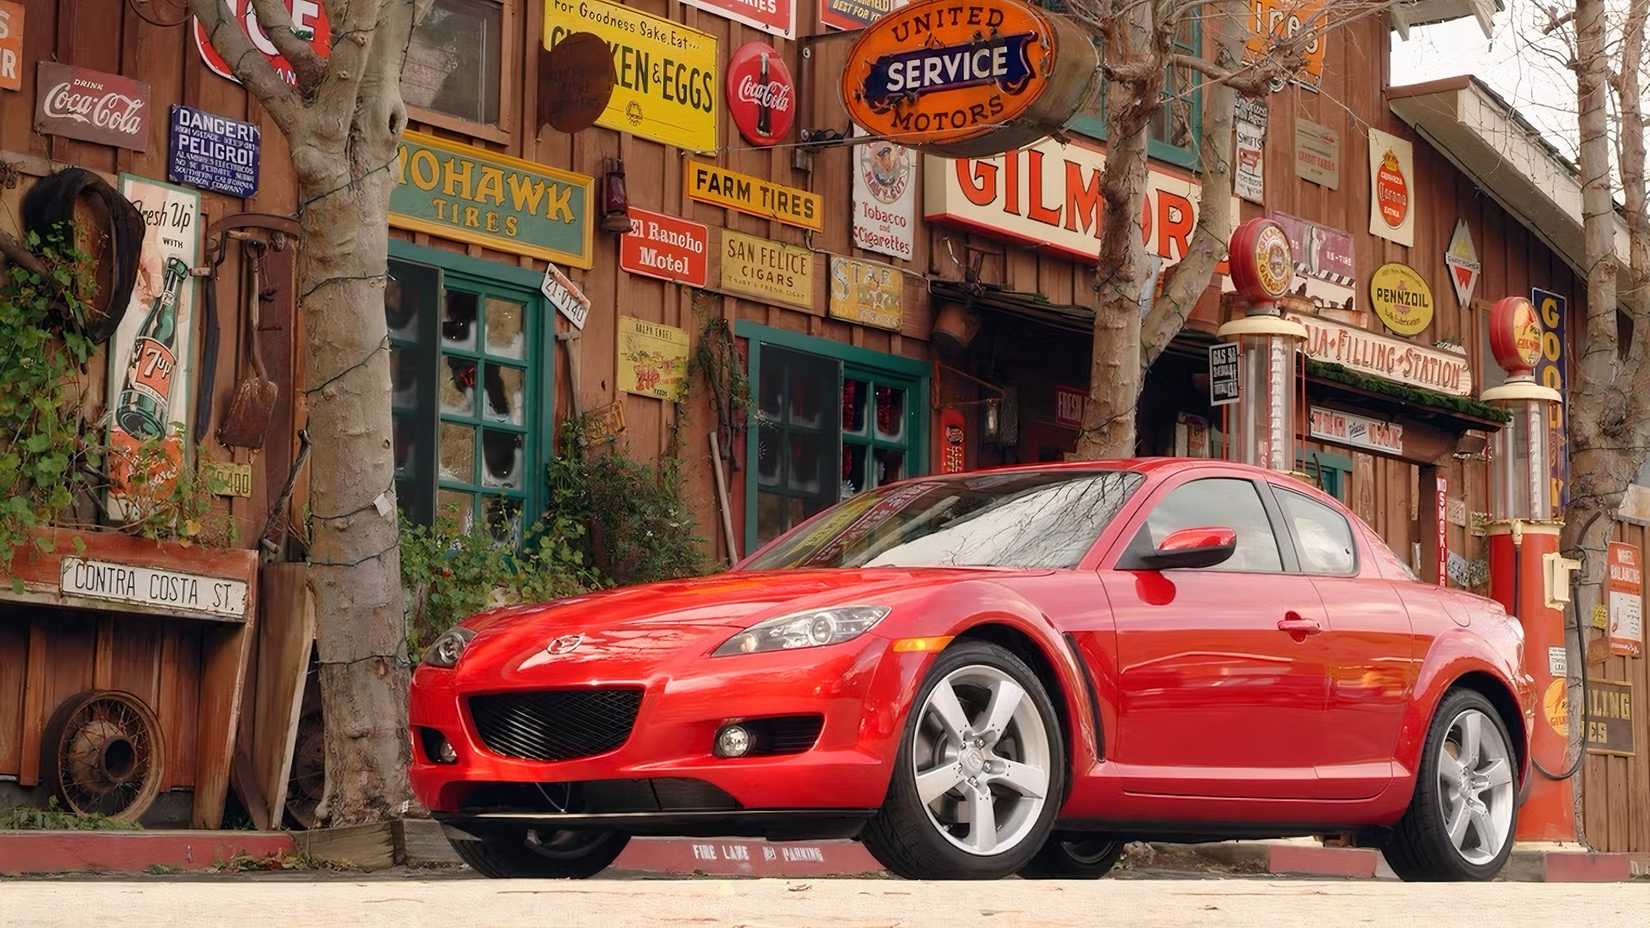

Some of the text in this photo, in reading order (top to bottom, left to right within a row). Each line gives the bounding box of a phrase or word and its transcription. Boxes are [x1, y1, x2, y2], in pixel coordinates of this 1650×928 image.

[553, 1, 574, 14] For
[579, 2, 635, 33] Goodness
[891, 6, 1004, 43] UNITED
[74, 79, 103, 91] DRINK
[652, 63, 662, 84] &
[662, 58, 712, 114] EGGS
[886, 46, 1008, 92] SERVICE
[43, 82, 145, 135] Coca-Cola
[738, 74, 790, 113] Coca-Cola
[179, 109, 254, 142] DANGER!
[891, 95, 1004, 132] MOTORS
[178, 134, 254, 167] PELIGRO!
[696, 169, 814, 219] FARM TIRES
[433, 198, 519, 238] TIRES
[862, 200, 907, 228] Tobacco
[162, 237, 184, 249] WITH
[629, 218, 703, 255] El Rancho
[639, 246, 689, 276] Motel
[727, 239, 807, 276] SAN FELICE
[741, 265, 794, 288] CIGARS
[1376, 287, 1429, 309] PENNZOIL
[1403, 346, 1461, 391] STATION
[74, 563, 235, 612] CONTRA COSTA ST.
[692, 844, 718, 861] FIRE
[721, 844, 750, 861] LANE
[782, 846, 825, 863] PARKING
